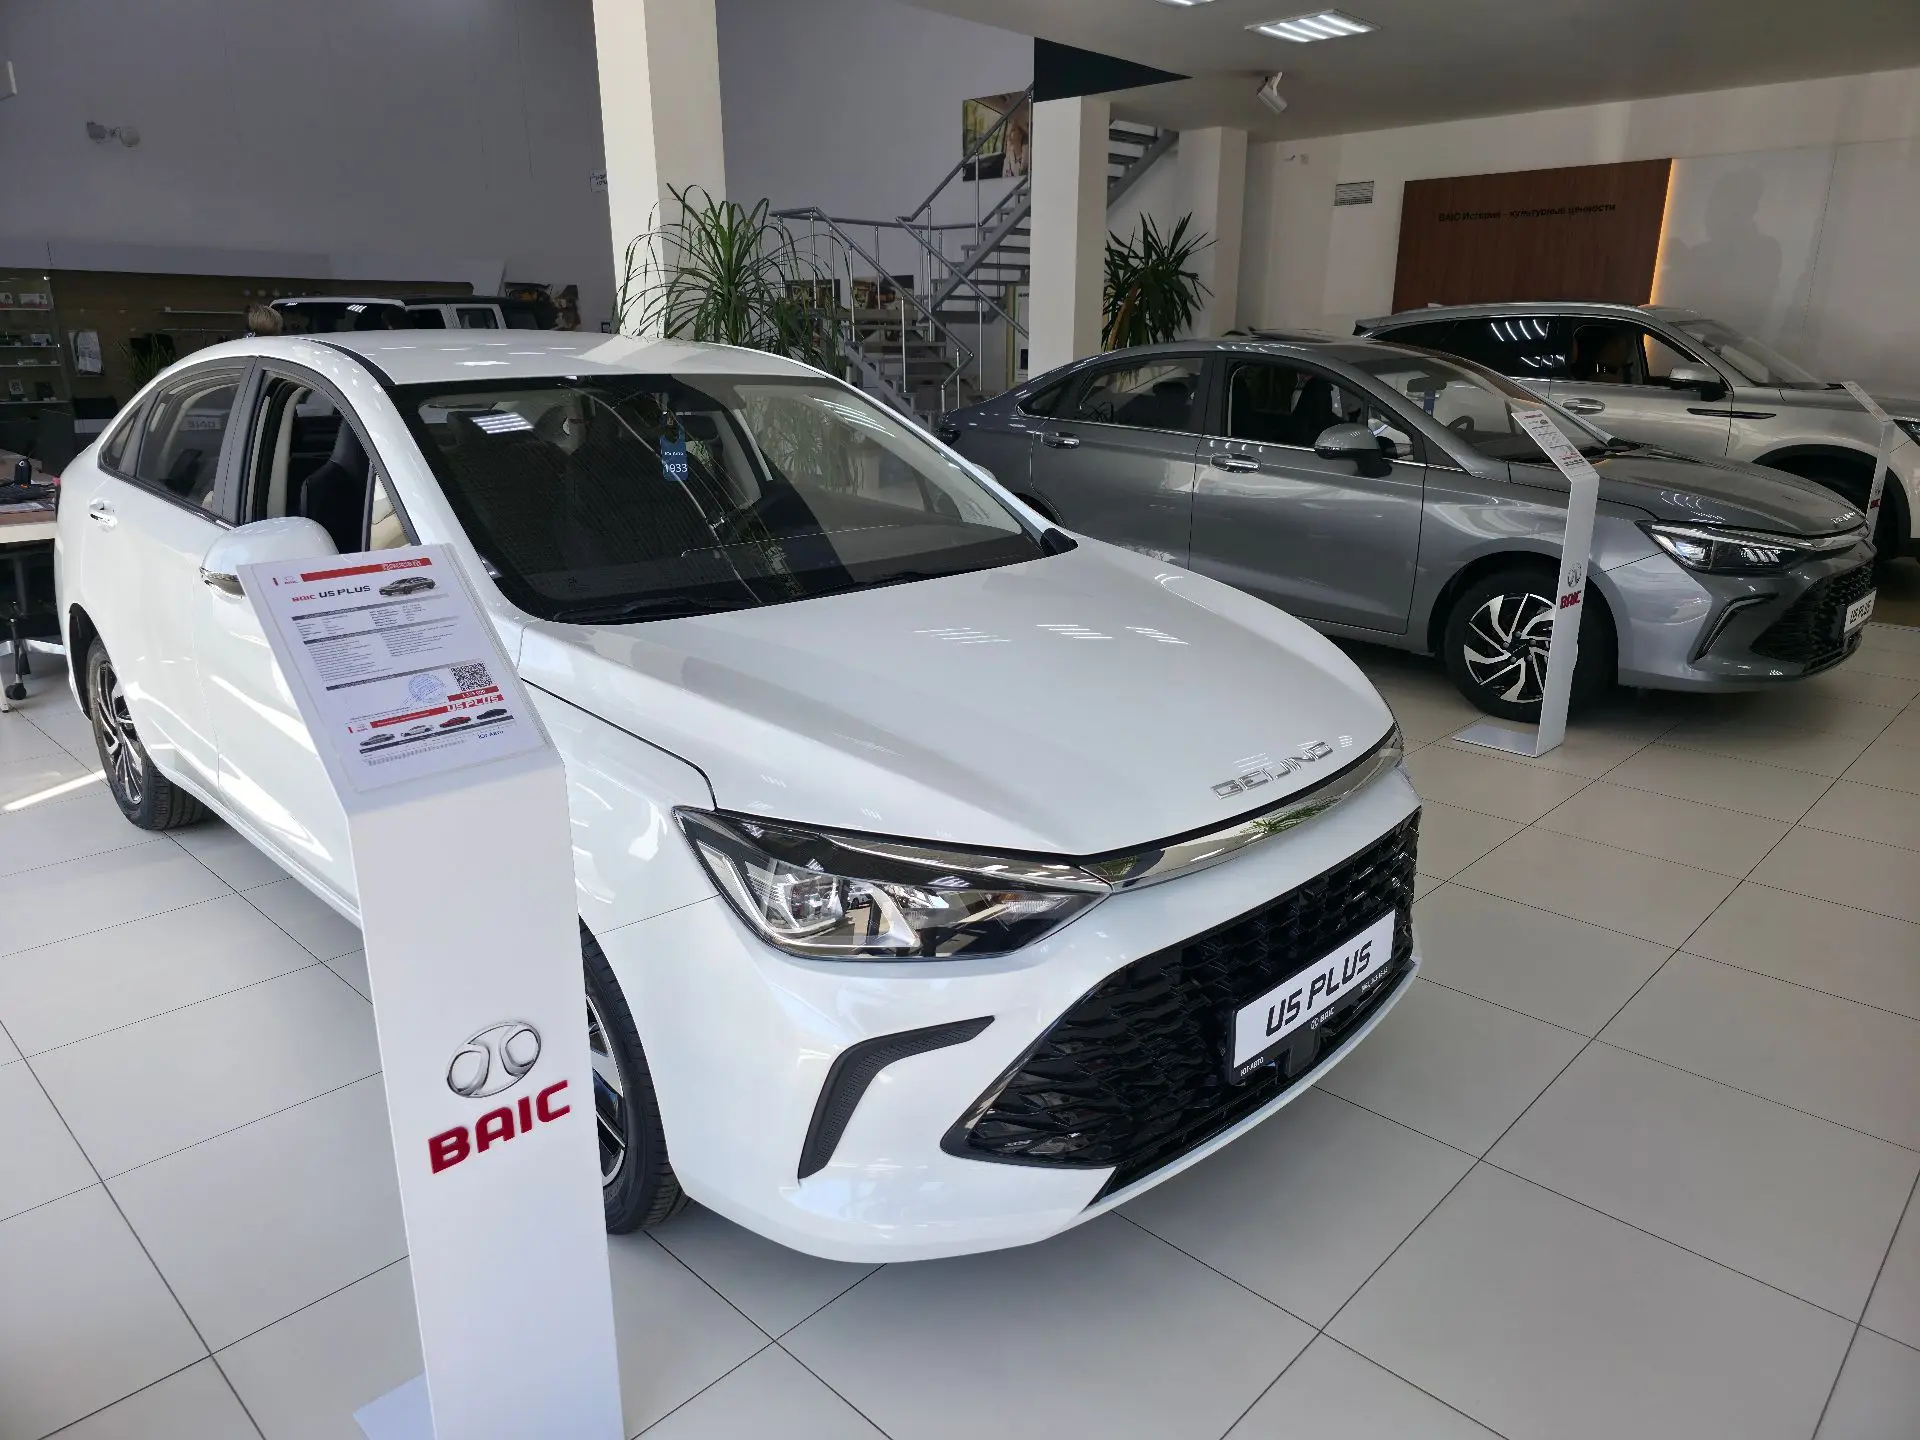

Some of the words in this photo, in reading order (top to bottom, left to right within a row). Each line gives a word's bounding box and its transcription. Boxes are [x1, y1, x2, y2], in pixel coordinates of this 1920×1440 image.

[663, 463, 688, 473] 1933
[336, 585, 371, 597] PLUS
[1210, 740, 1334, 800] BEIJING
[1306, 939, 1373, 1011] PLUS
[427, 1079, 572, 1175] BAIC
